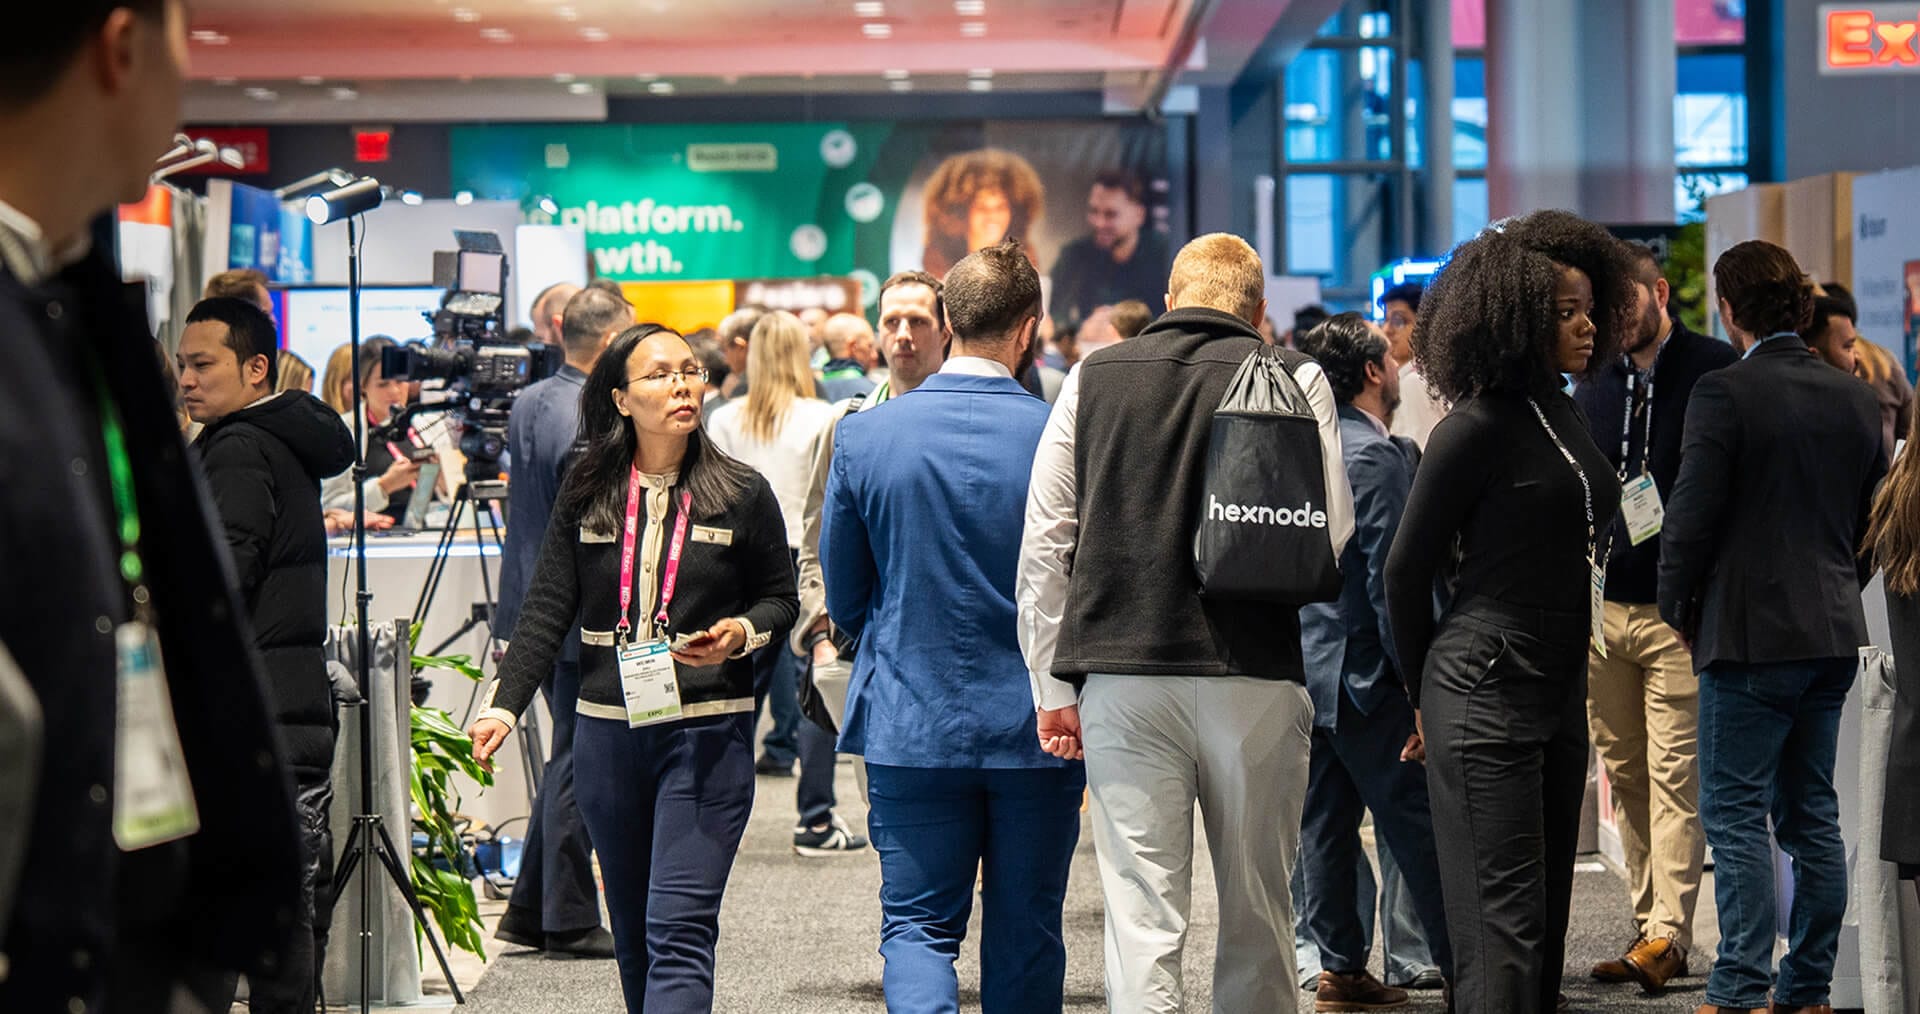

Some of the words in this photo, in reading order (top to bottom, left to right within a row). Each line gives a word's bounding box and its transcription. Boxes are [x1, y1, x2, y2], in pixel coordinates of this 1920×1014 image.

[1827, 10, 1920, 68] Ex
[561, 198, 743, 234] platform.
[594, 240, 683, 274] wth.
[1208, 493, 1327, 528] hexnode
